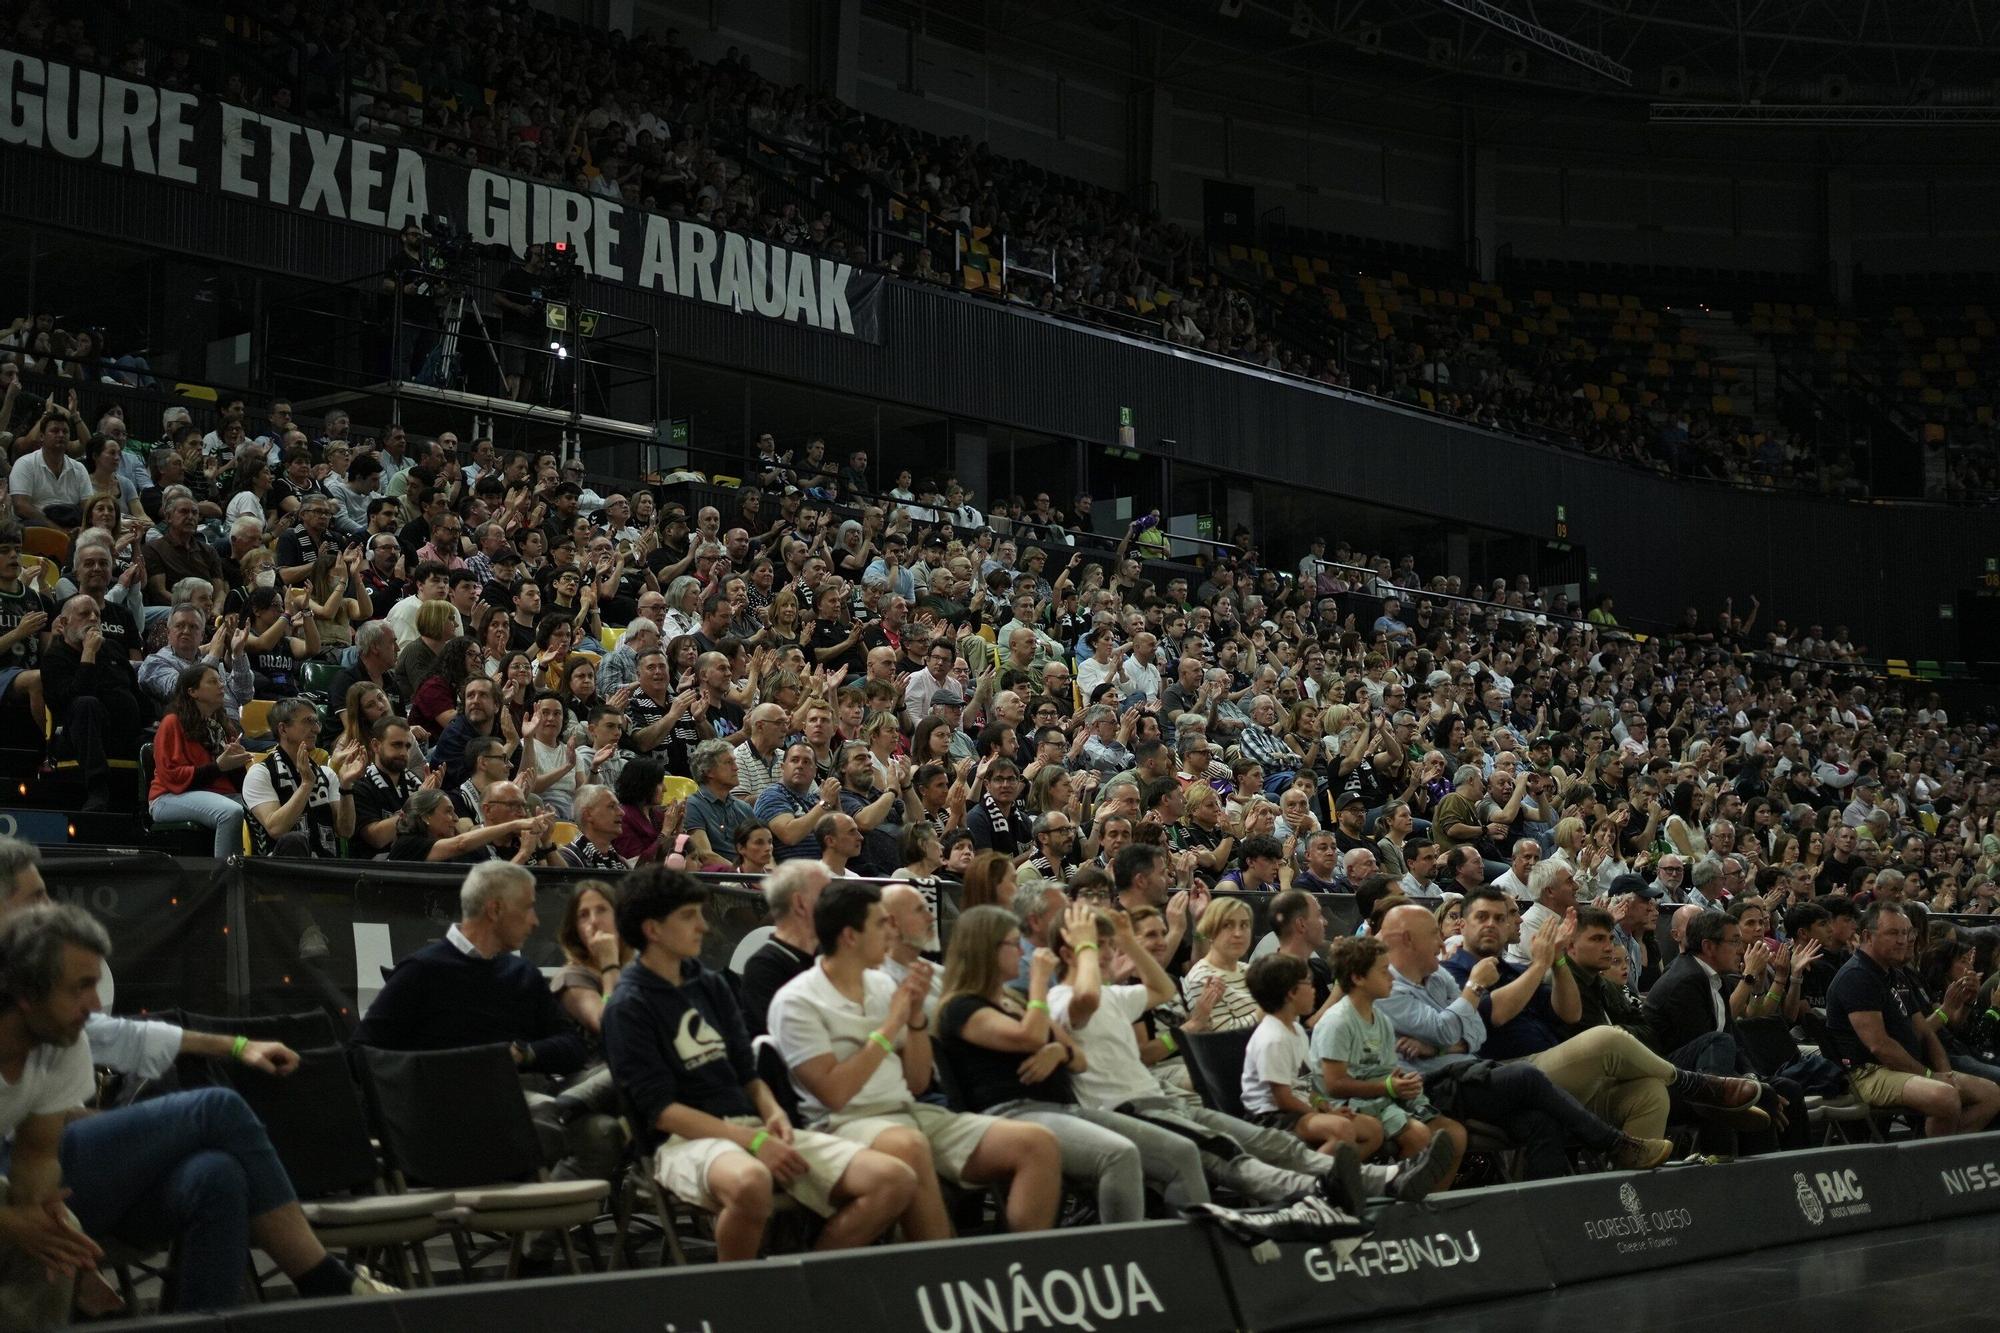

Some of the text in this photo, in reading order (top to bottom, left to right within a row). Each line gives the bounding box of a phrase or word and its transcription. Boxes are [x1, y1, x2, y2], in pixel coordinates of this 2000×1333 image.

[0, 48, 855, 335] GURE ETXEA GURE ARAUAK
[1199, 521, 1211, 529] 215
[1556, 523, 1567, 538] 09
[1985, 573, 2000, 587] 08
[258, 655, 293, 671] BILBAO
[1815, 1168, 1864, 1204] RAC
[1584, 1215, 1631, 1240] FLORES
[1651, 1207, 1693, 1232] QUESO
[916, 1260, 1166, 1333] UNÁQUA
